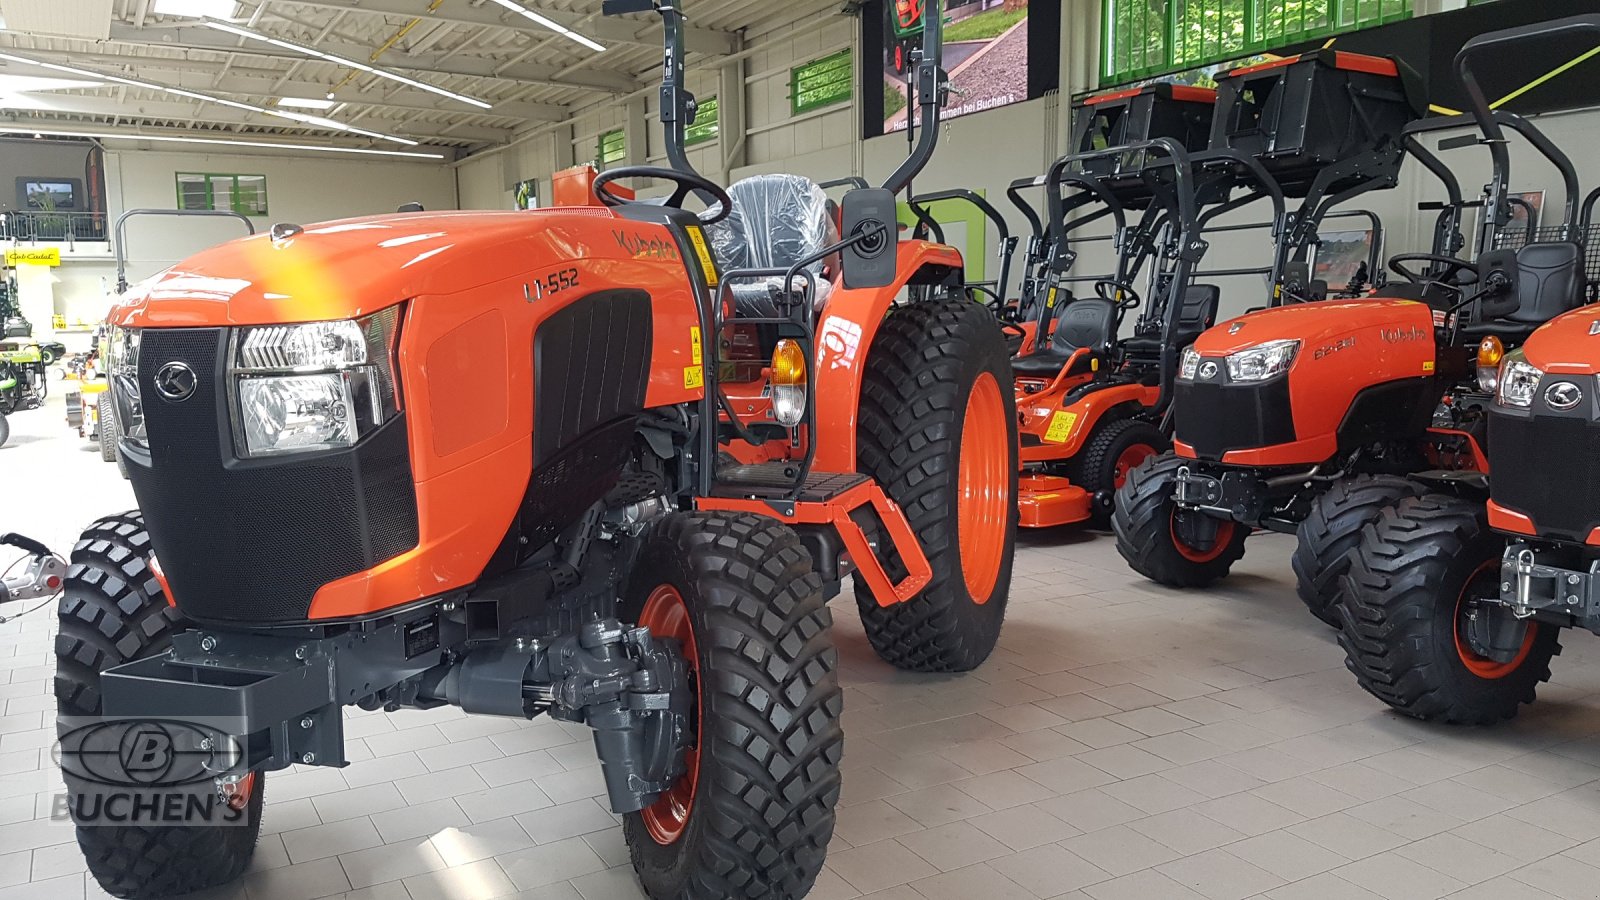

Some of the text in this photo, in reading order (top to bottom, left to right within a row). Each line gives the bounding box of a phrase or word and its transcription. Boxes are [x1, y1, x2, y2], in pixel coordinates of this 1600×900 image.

[893, 117, 920, 131] Herzch
[963, 102, 976, 114] bei
[612, 229, 678, 260] Kubota
[523, 268, 580, 304] L1-552
